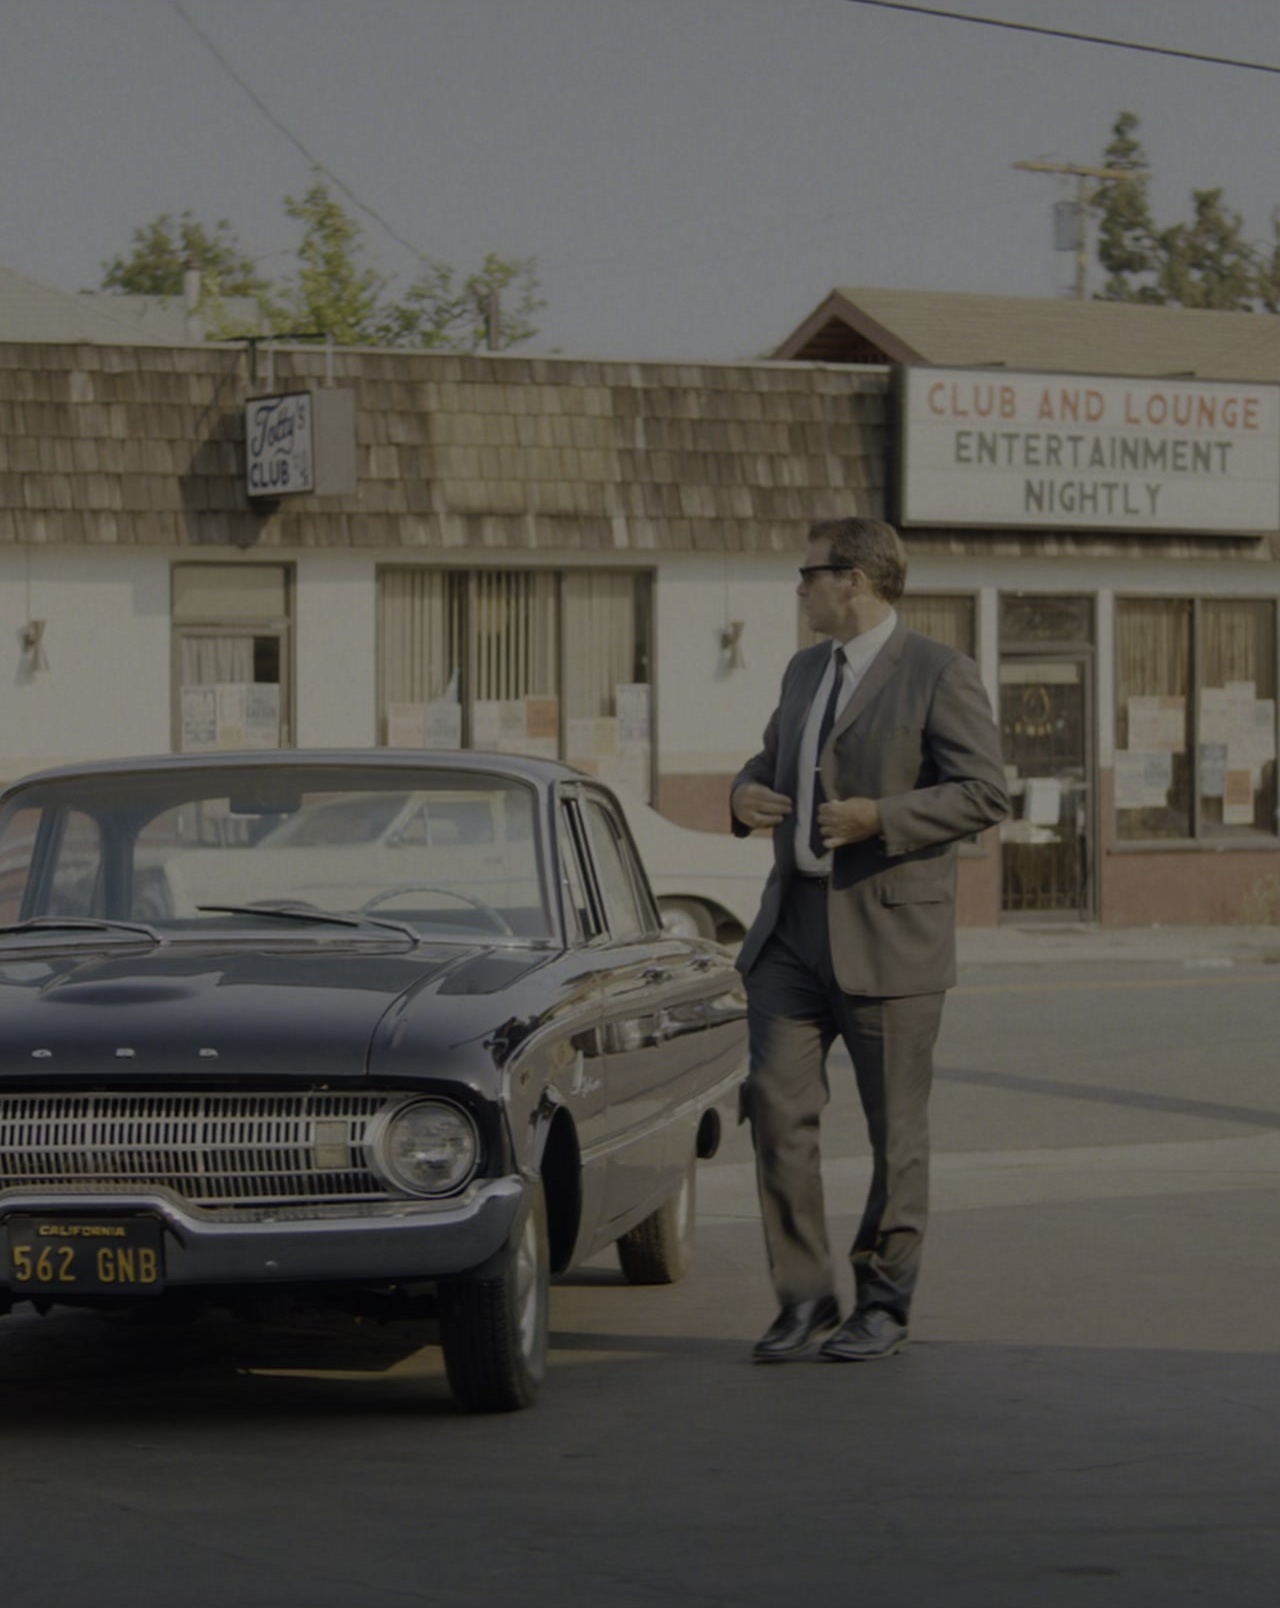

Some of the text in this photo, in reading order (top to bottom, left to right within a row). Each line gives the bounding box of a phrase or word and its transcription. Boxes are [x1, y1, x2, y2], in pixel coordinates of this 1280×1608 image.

[927, 383, 1261, 431] CLUB AND LOUNGE
[954, 430, 1233, 474] ENTERTAINMENT
[250, 460, 290, 489] CLUB
[1024, 478, 1163, 515] NIGHTLY
[37, 1224, 127, 1238] CALIFORNIA
[12, 1245, 158, 1284] 562 GNB
